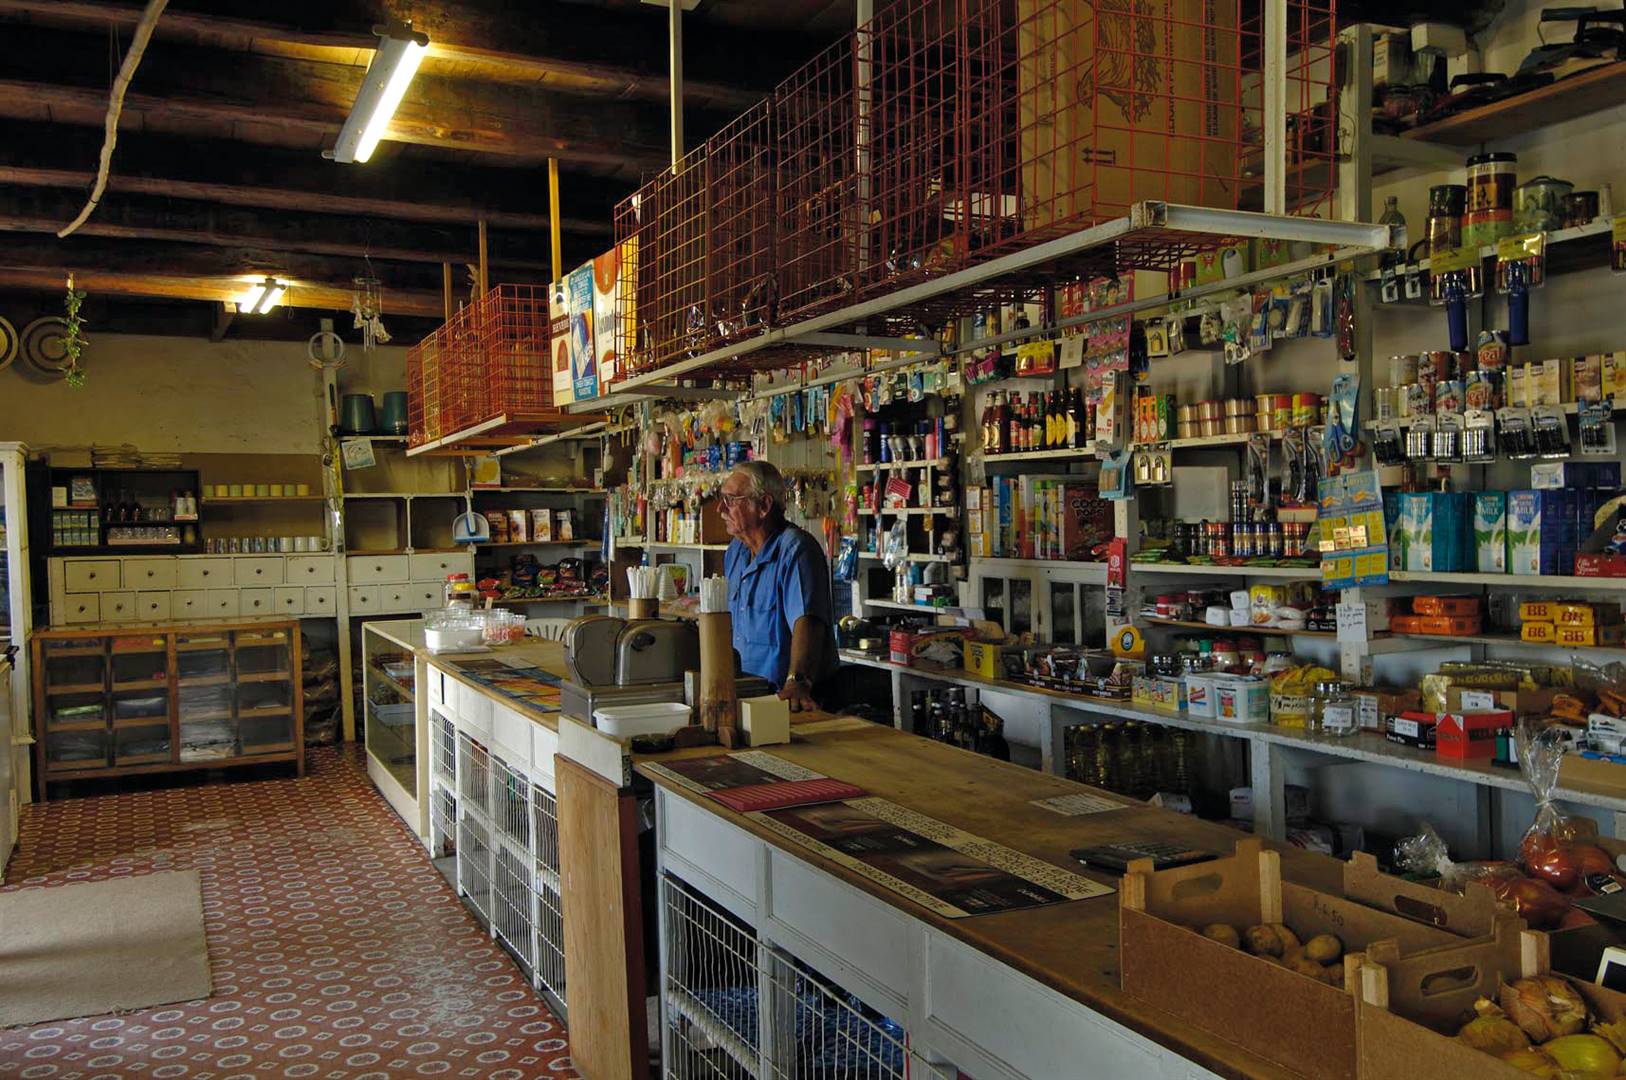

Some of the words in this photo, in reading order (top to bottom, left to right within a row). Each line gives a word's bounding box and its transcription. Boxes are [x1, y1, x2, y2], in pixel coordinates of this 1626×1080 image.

[1527, 605, 1548, 616] BB
[1528, 627, 1546, 637] BB
[1564, 631, 1585, 642] BB
